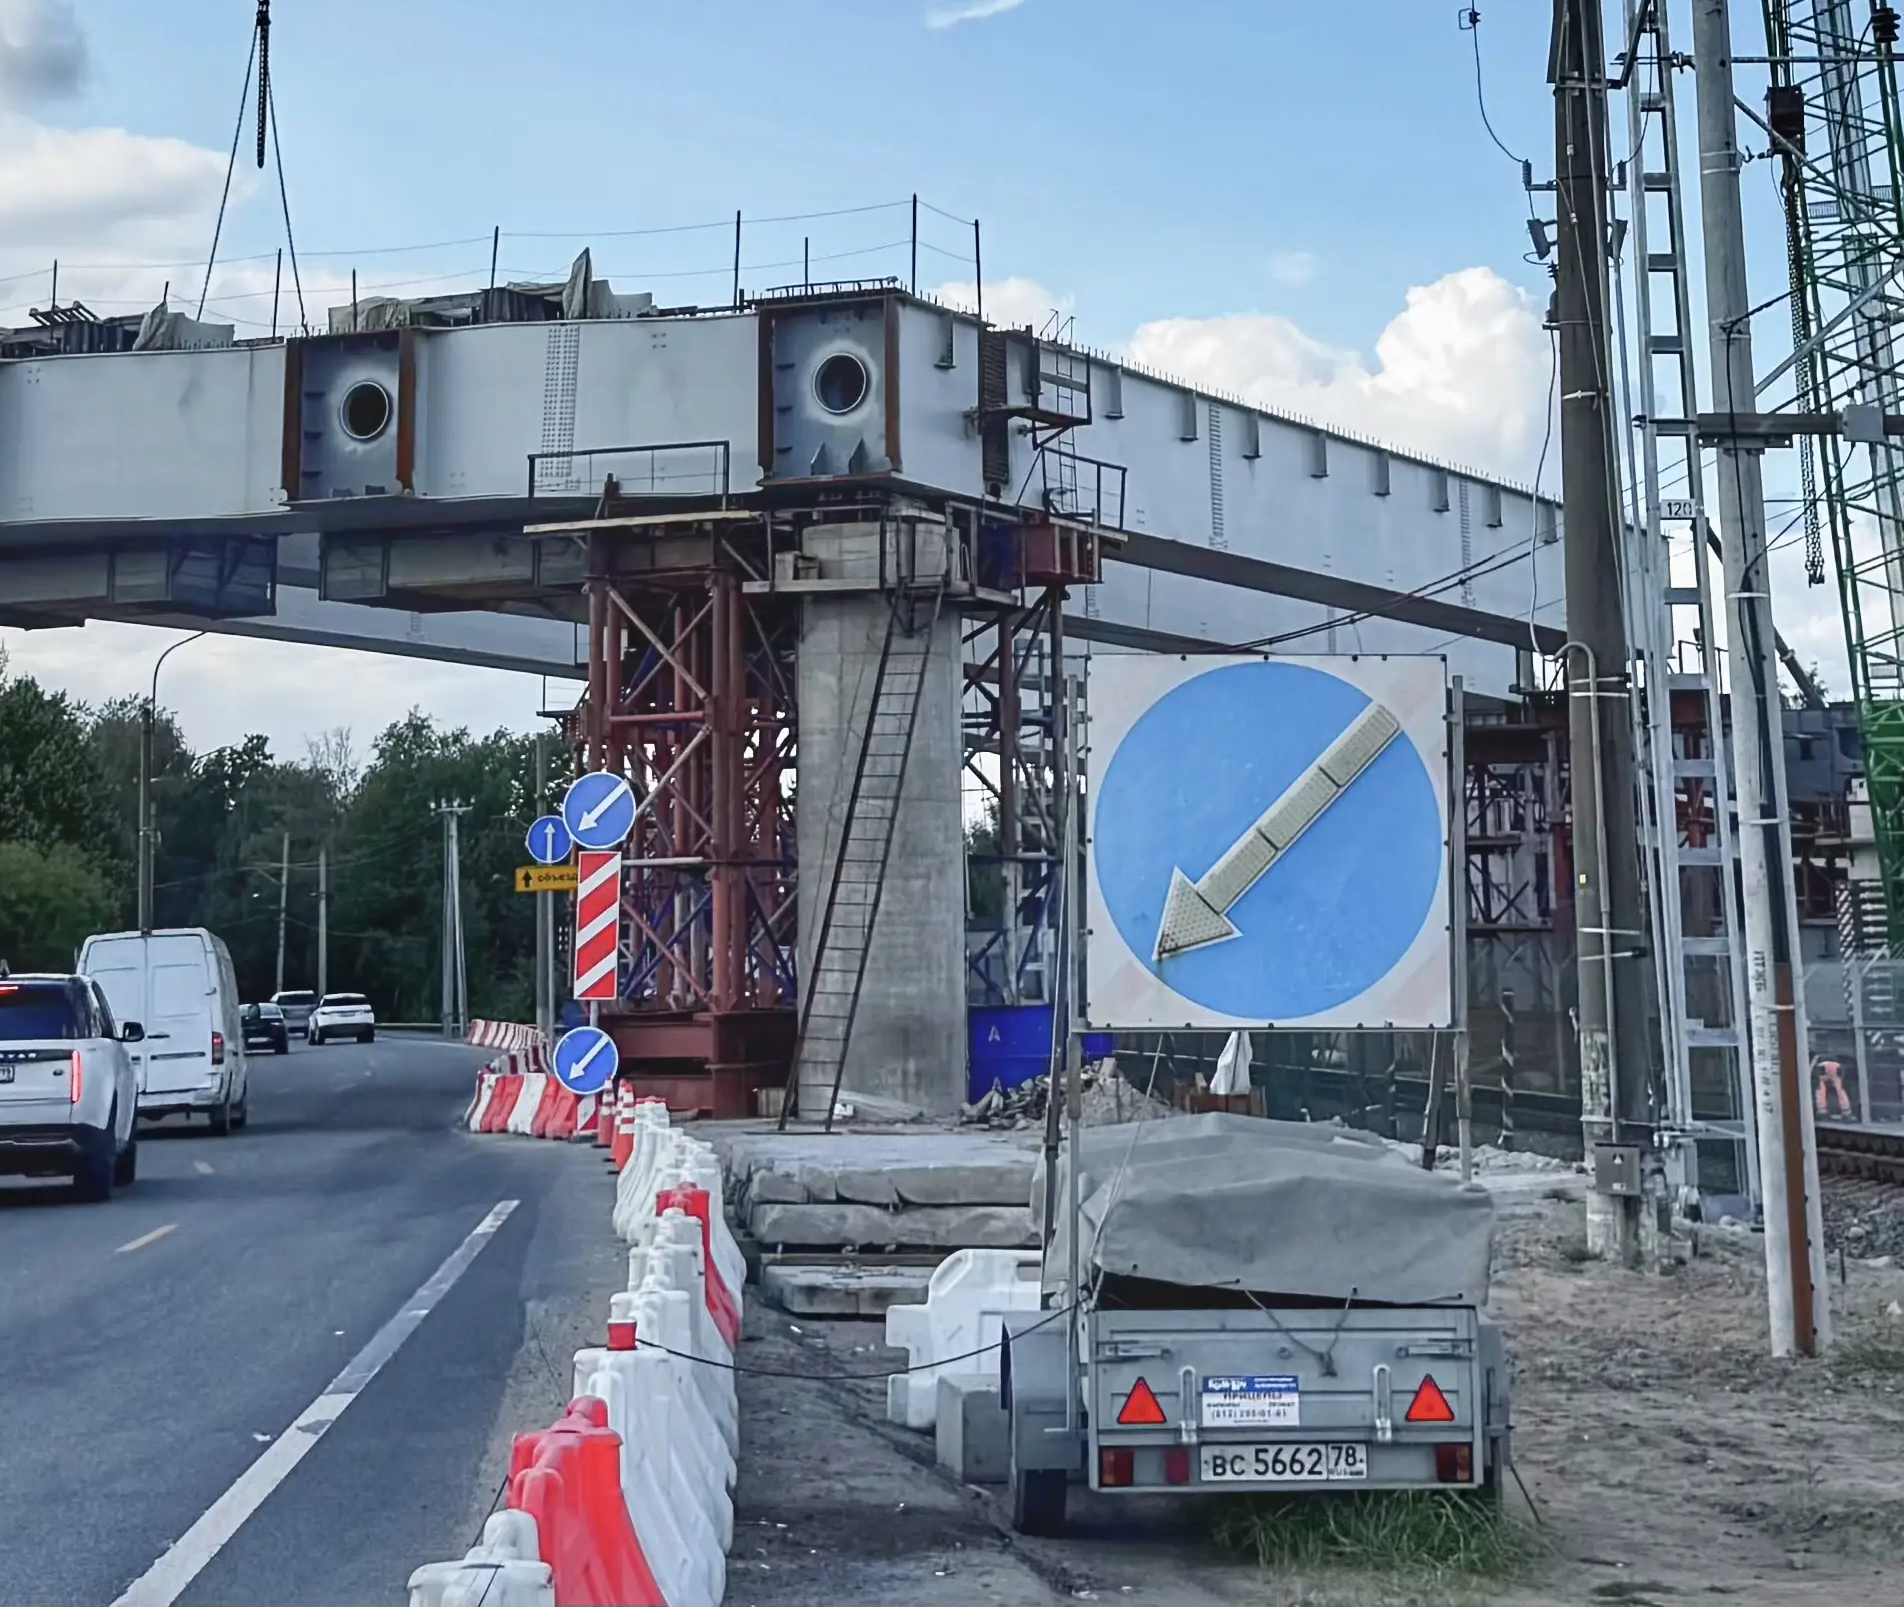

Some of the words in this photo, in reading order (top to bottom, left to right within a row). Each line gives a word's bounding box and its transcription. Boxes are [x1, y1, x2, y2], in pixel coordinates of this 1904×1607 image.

[1667, 501, 1693, 516] 120
[1253, 1447, 1323, 1476] 5662
[1330, 1445, 1357, 1467] 78
